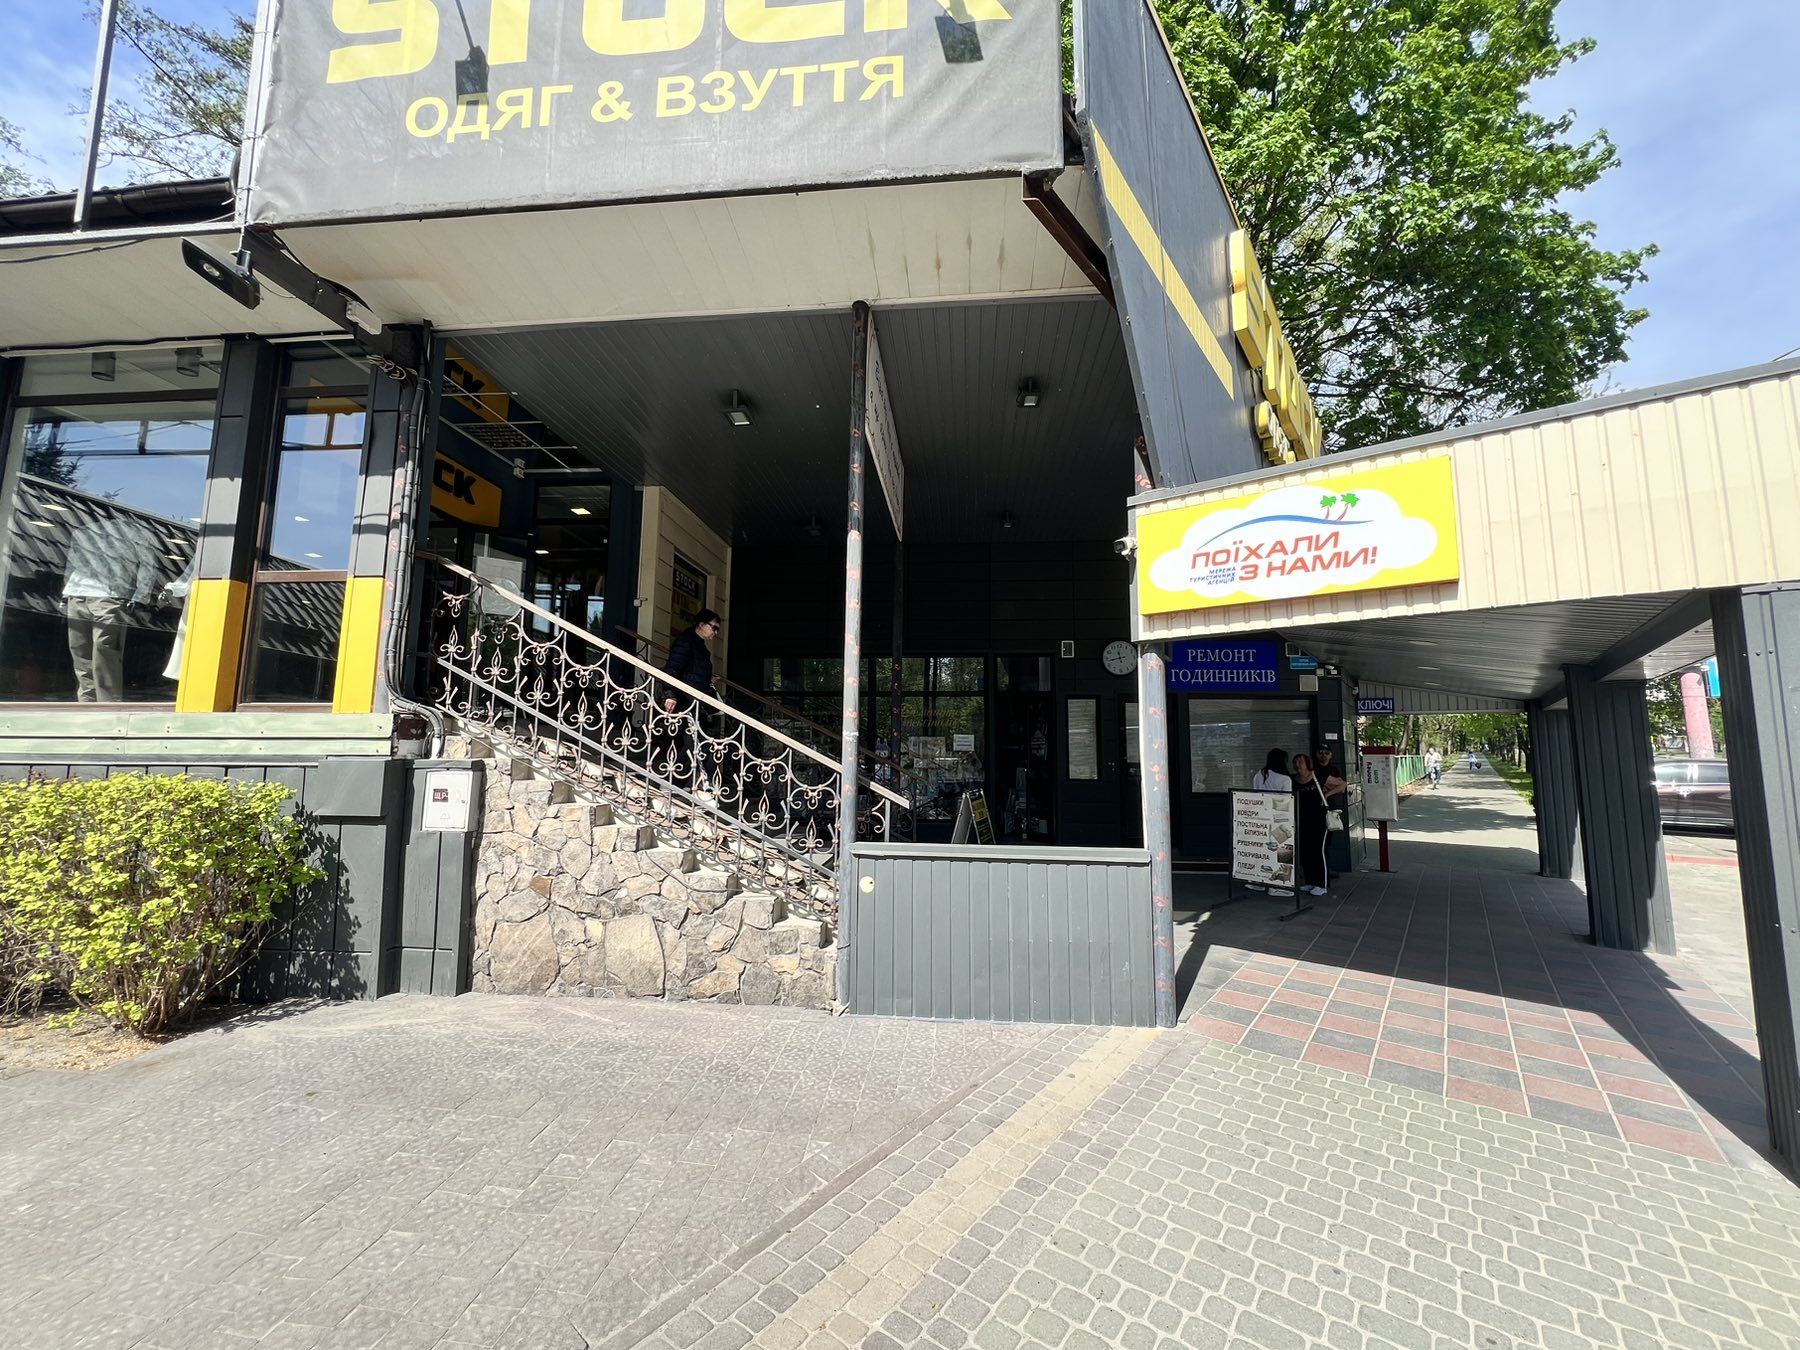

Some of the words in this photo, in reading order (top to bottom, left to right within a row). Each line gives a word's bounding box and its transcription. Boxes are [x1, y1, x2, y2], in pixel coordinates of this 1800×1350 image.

[406, 84, 572, 143] ОДЯГ
[590, 81, 632, 124] &
[655, 55, 905, 118] ВЗУТТЯ
[1191, 531, 1340, 570] ПОЇХАЛИ
[1266, 546, 1378, 578] НАМИ!
[1209, 567, 1236, 575] МЕРЕЖА
[1187, 649, 1257, 663] РЕМОНТ
[1170, 669, 1277, 684] ГОДИННИКІВ
[1357, 699, 1393, 710] КЛЮЧІ
[1237, 798, 1264, 806] ПОДУШКИ
[1237, 850, 1270, 861] ПОКРИВАЛА
